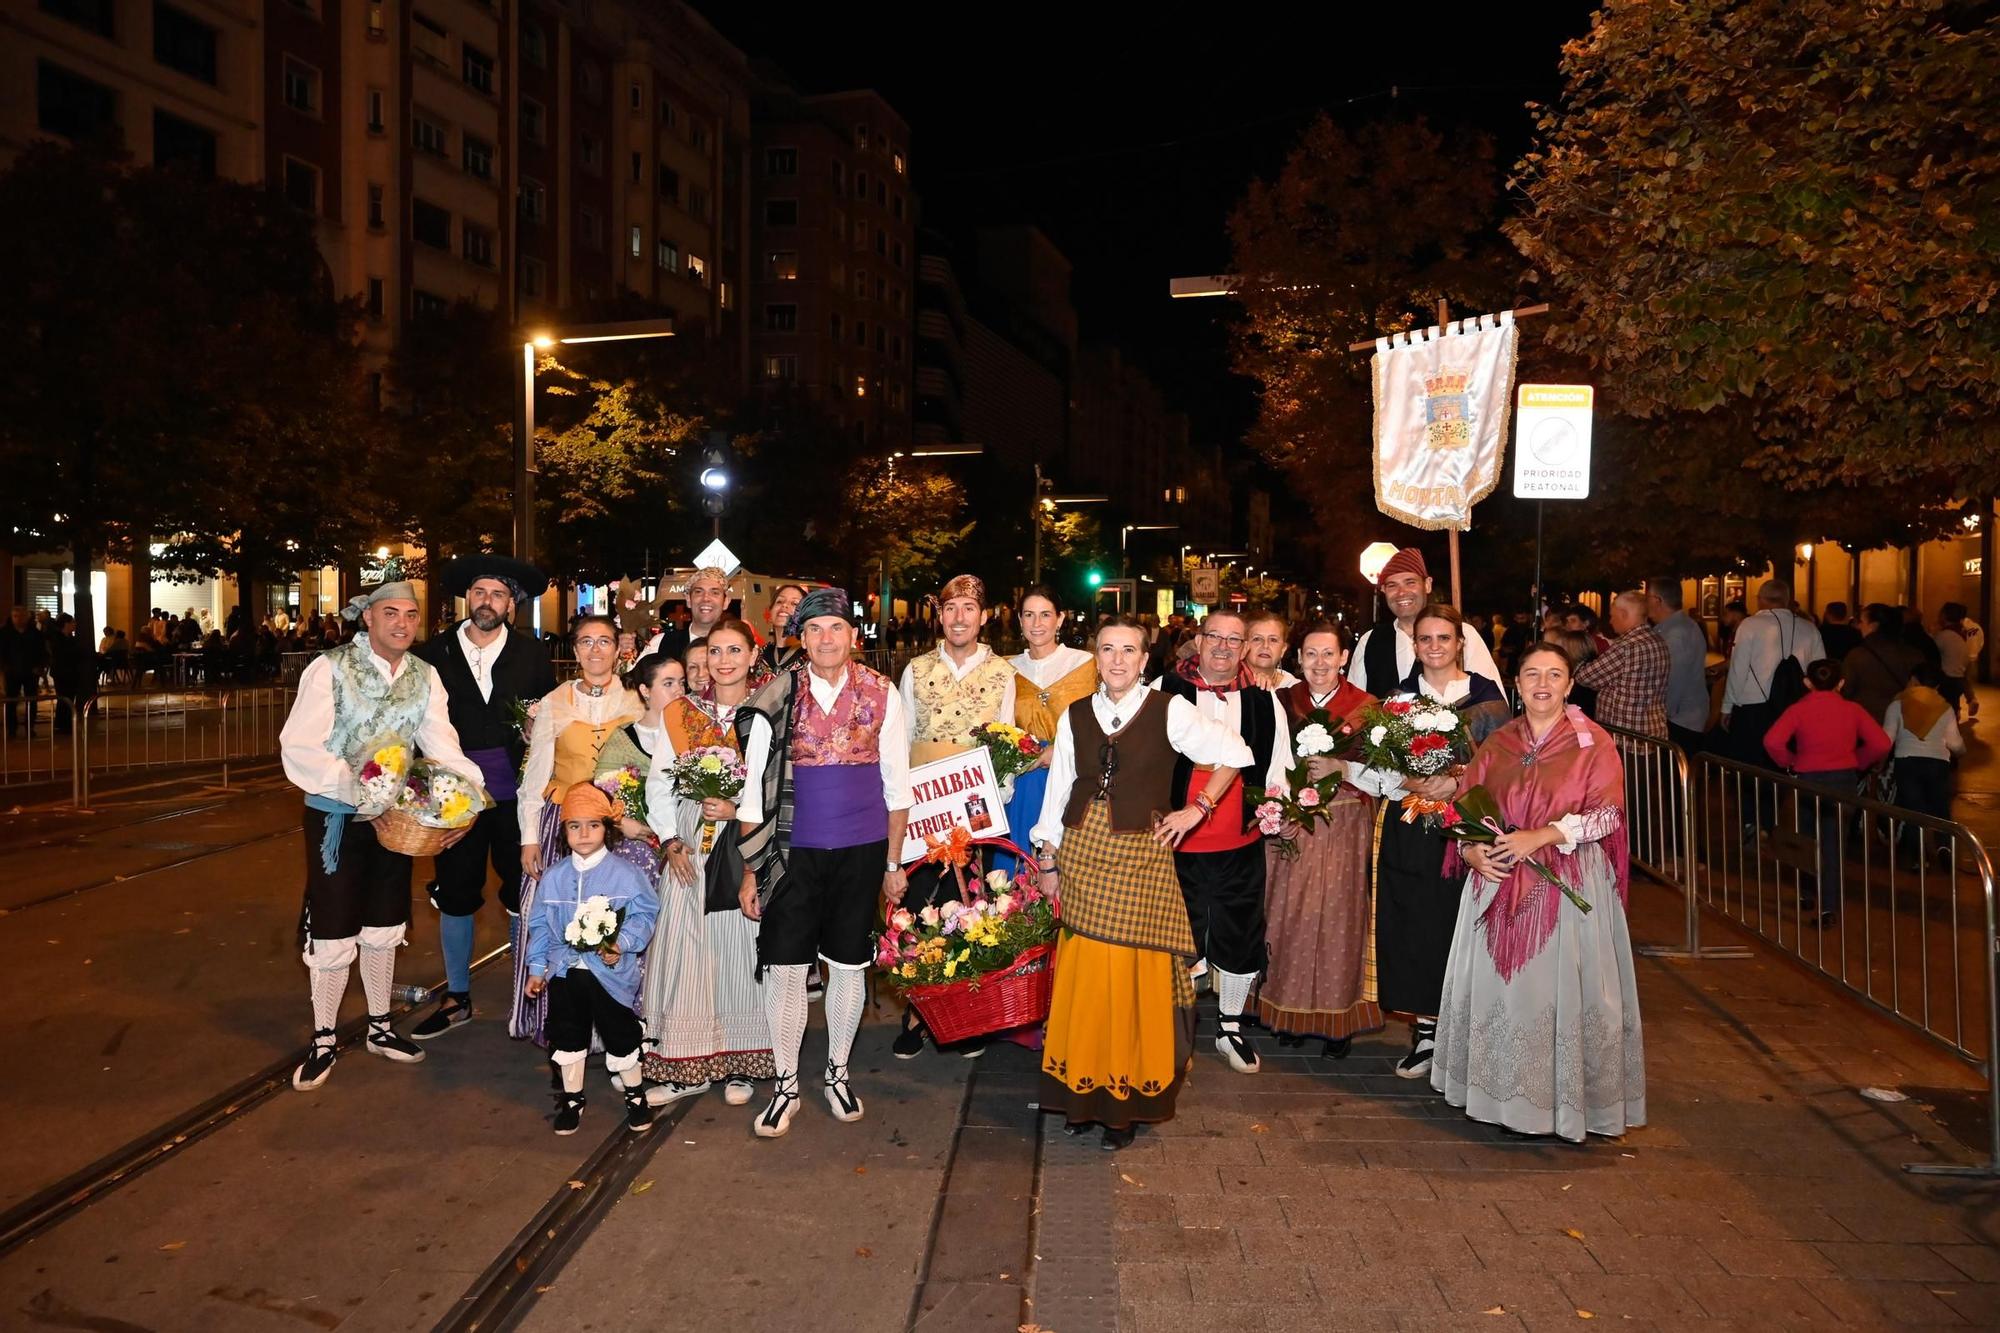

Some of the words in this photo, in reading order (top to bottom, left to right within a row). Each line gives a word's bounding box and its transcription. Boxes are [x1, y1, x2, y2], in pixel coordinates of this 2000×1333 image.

[1523, 469, 1582, 478] PRIORIDAD
[1388, 480, 1465, 507] MONTA
[1523, 482, 1580, 491] PEATONAL
[911, 765, 985, 805] NTALBÁN
